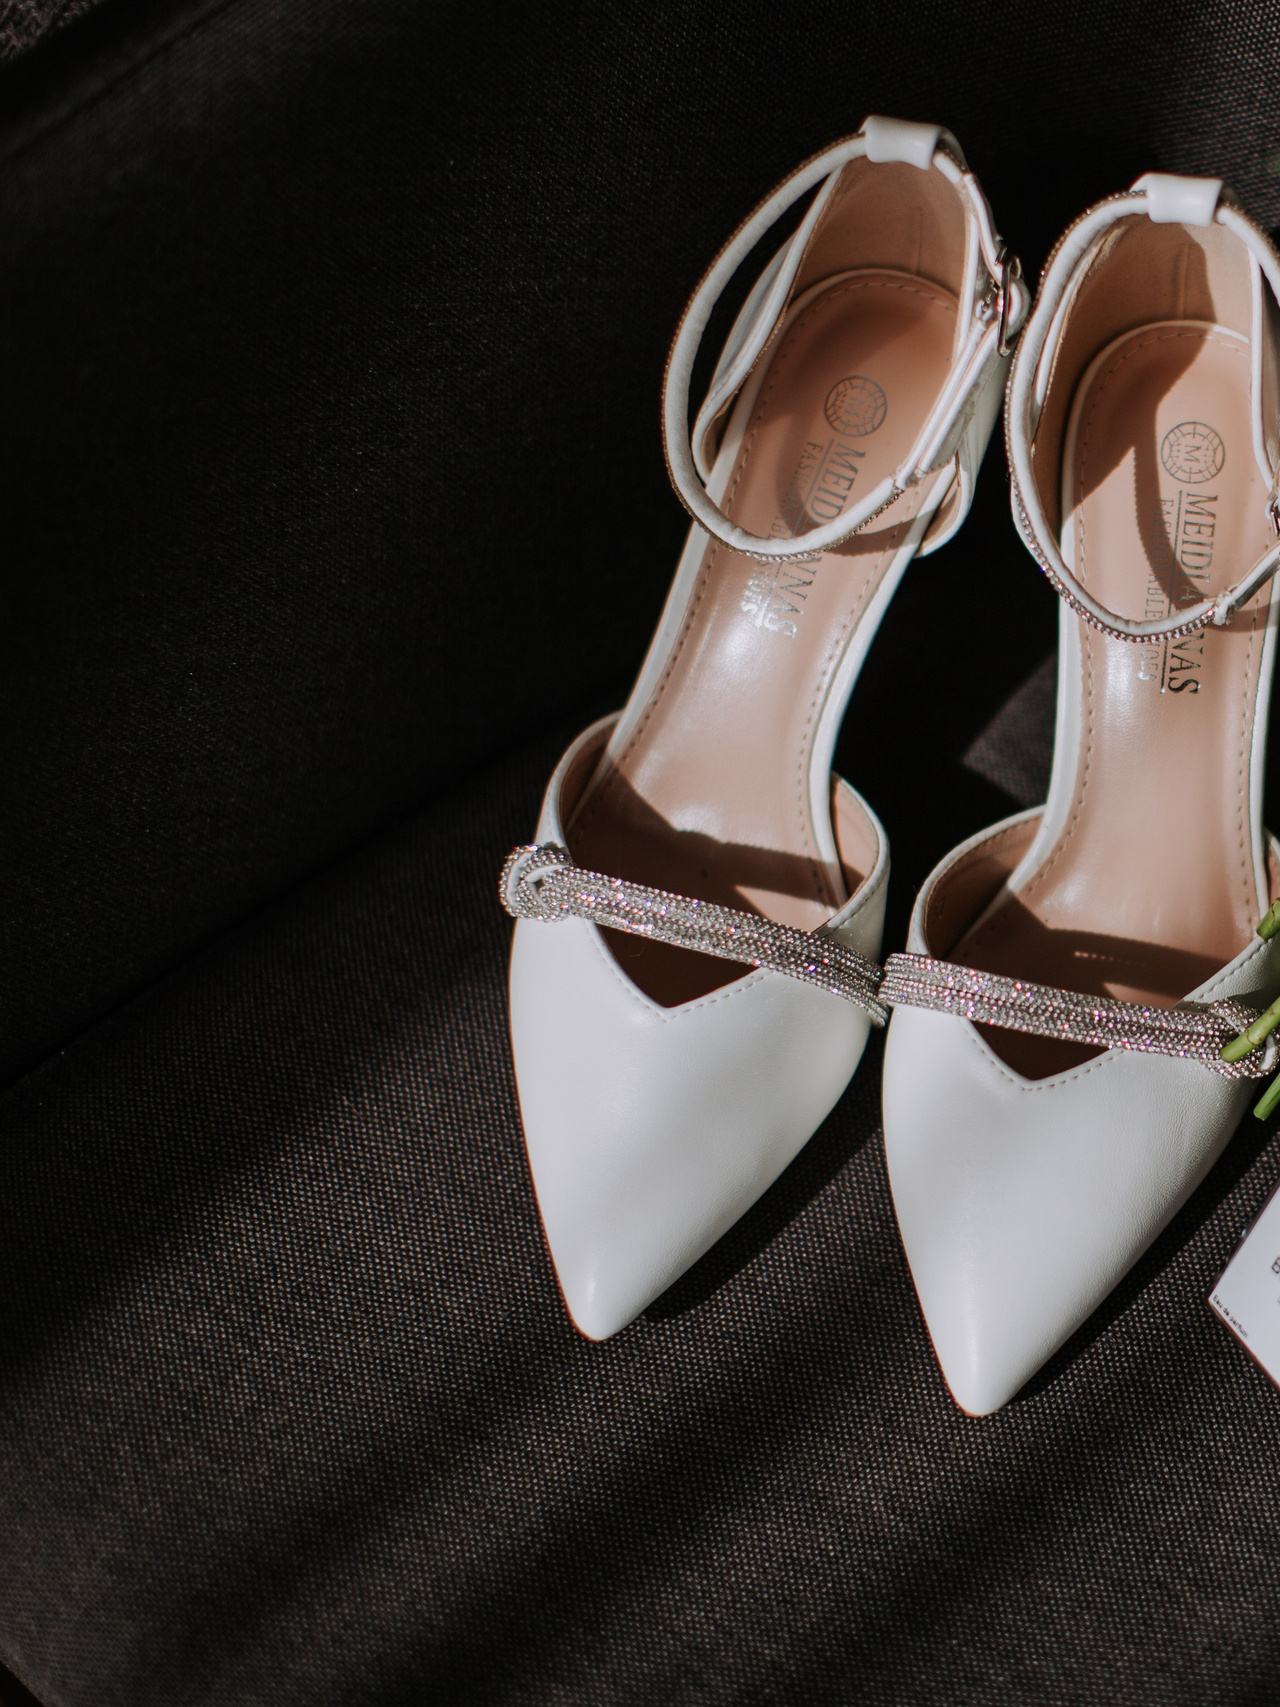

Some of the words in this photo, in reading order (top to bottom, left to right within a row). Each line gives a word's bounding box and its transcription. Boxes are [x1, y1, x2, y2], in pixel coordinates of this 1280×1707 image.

[761, 441, 866, 639] MEIDNNAS
[1167, 492, 1217, 694] MEIDIANAS
[1212, 1294, 1224, 1308] Eau
[1222, 1306, 1230, 1316] de
[1229, 1316, 1248, 1337] parfum
